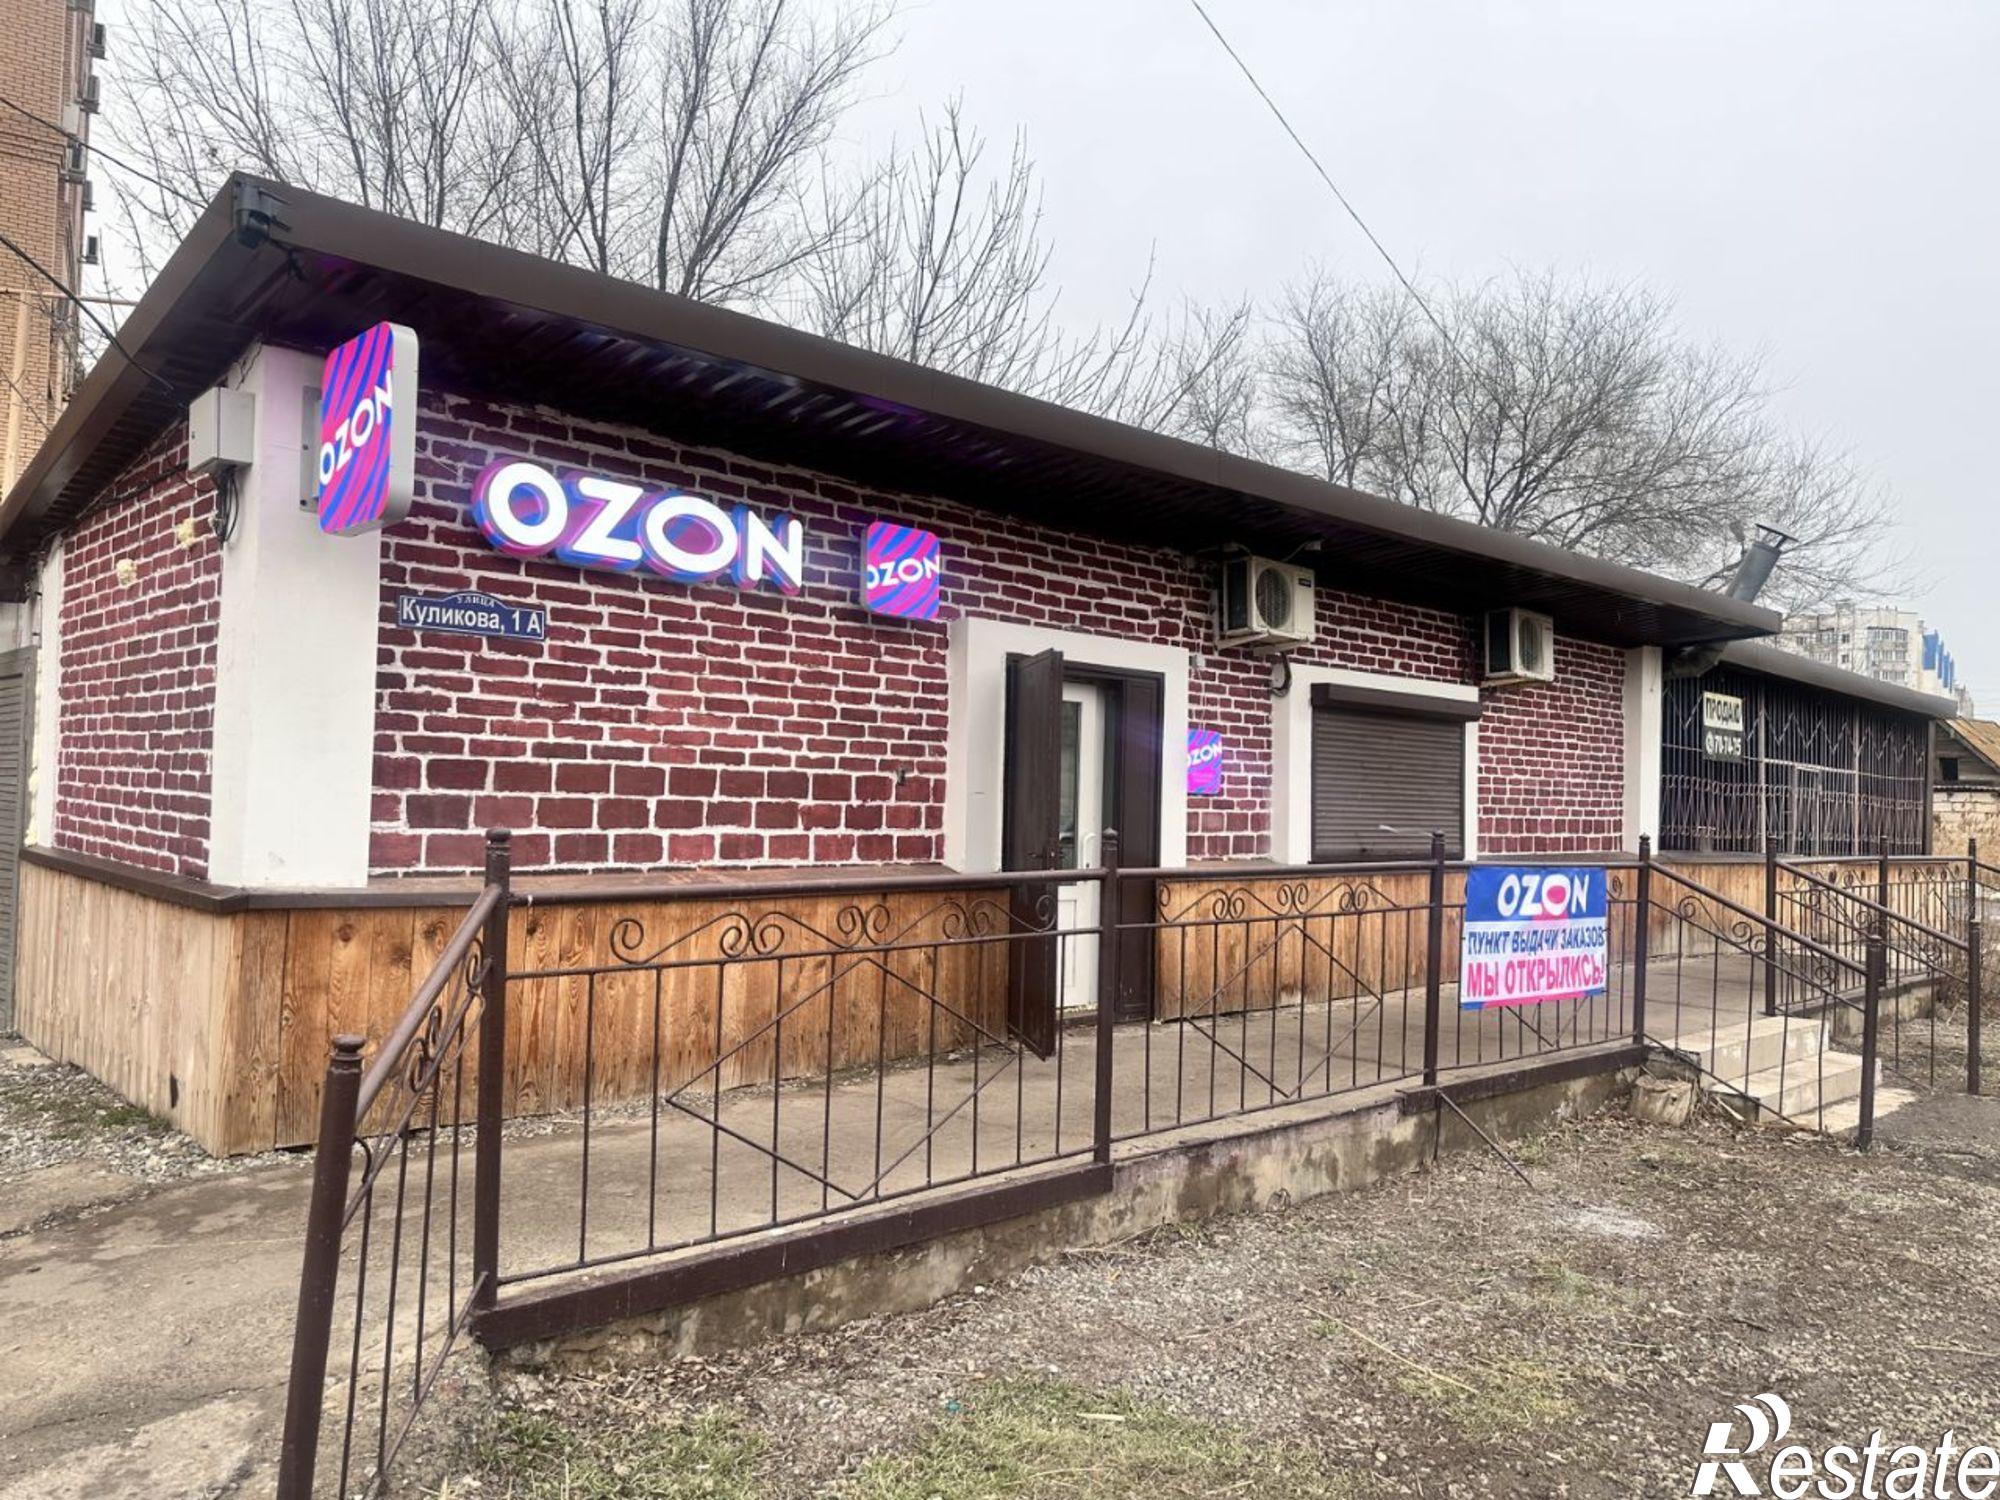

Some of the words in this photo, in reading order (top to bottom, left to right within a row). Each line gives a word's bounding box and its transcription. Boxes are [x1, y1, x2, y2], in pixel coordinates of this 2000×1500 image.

[320, 369, 393, 485] OZON
[487, 461, 803, 588] OZON
[866, 554, 940, 590] OZON
[402, 599, 505, 634] Куликова,
[511, 609, 521, 632] 1
[1705, 698, 1741, 723] ПРОДАЮ
[1497, 874, 1589, 917] OZON
[1467, 930, 1510, 955] ПУНКТ
[1511, 928, 1559, 955] ВЫДАЧИ
[1561, 926, 1605, 949] ЗАКАЗОВ
[1466, 961, 1499, 998] МЫ
[1504, 953, 1606, 995] ОТКРЫЛИСЬ!
